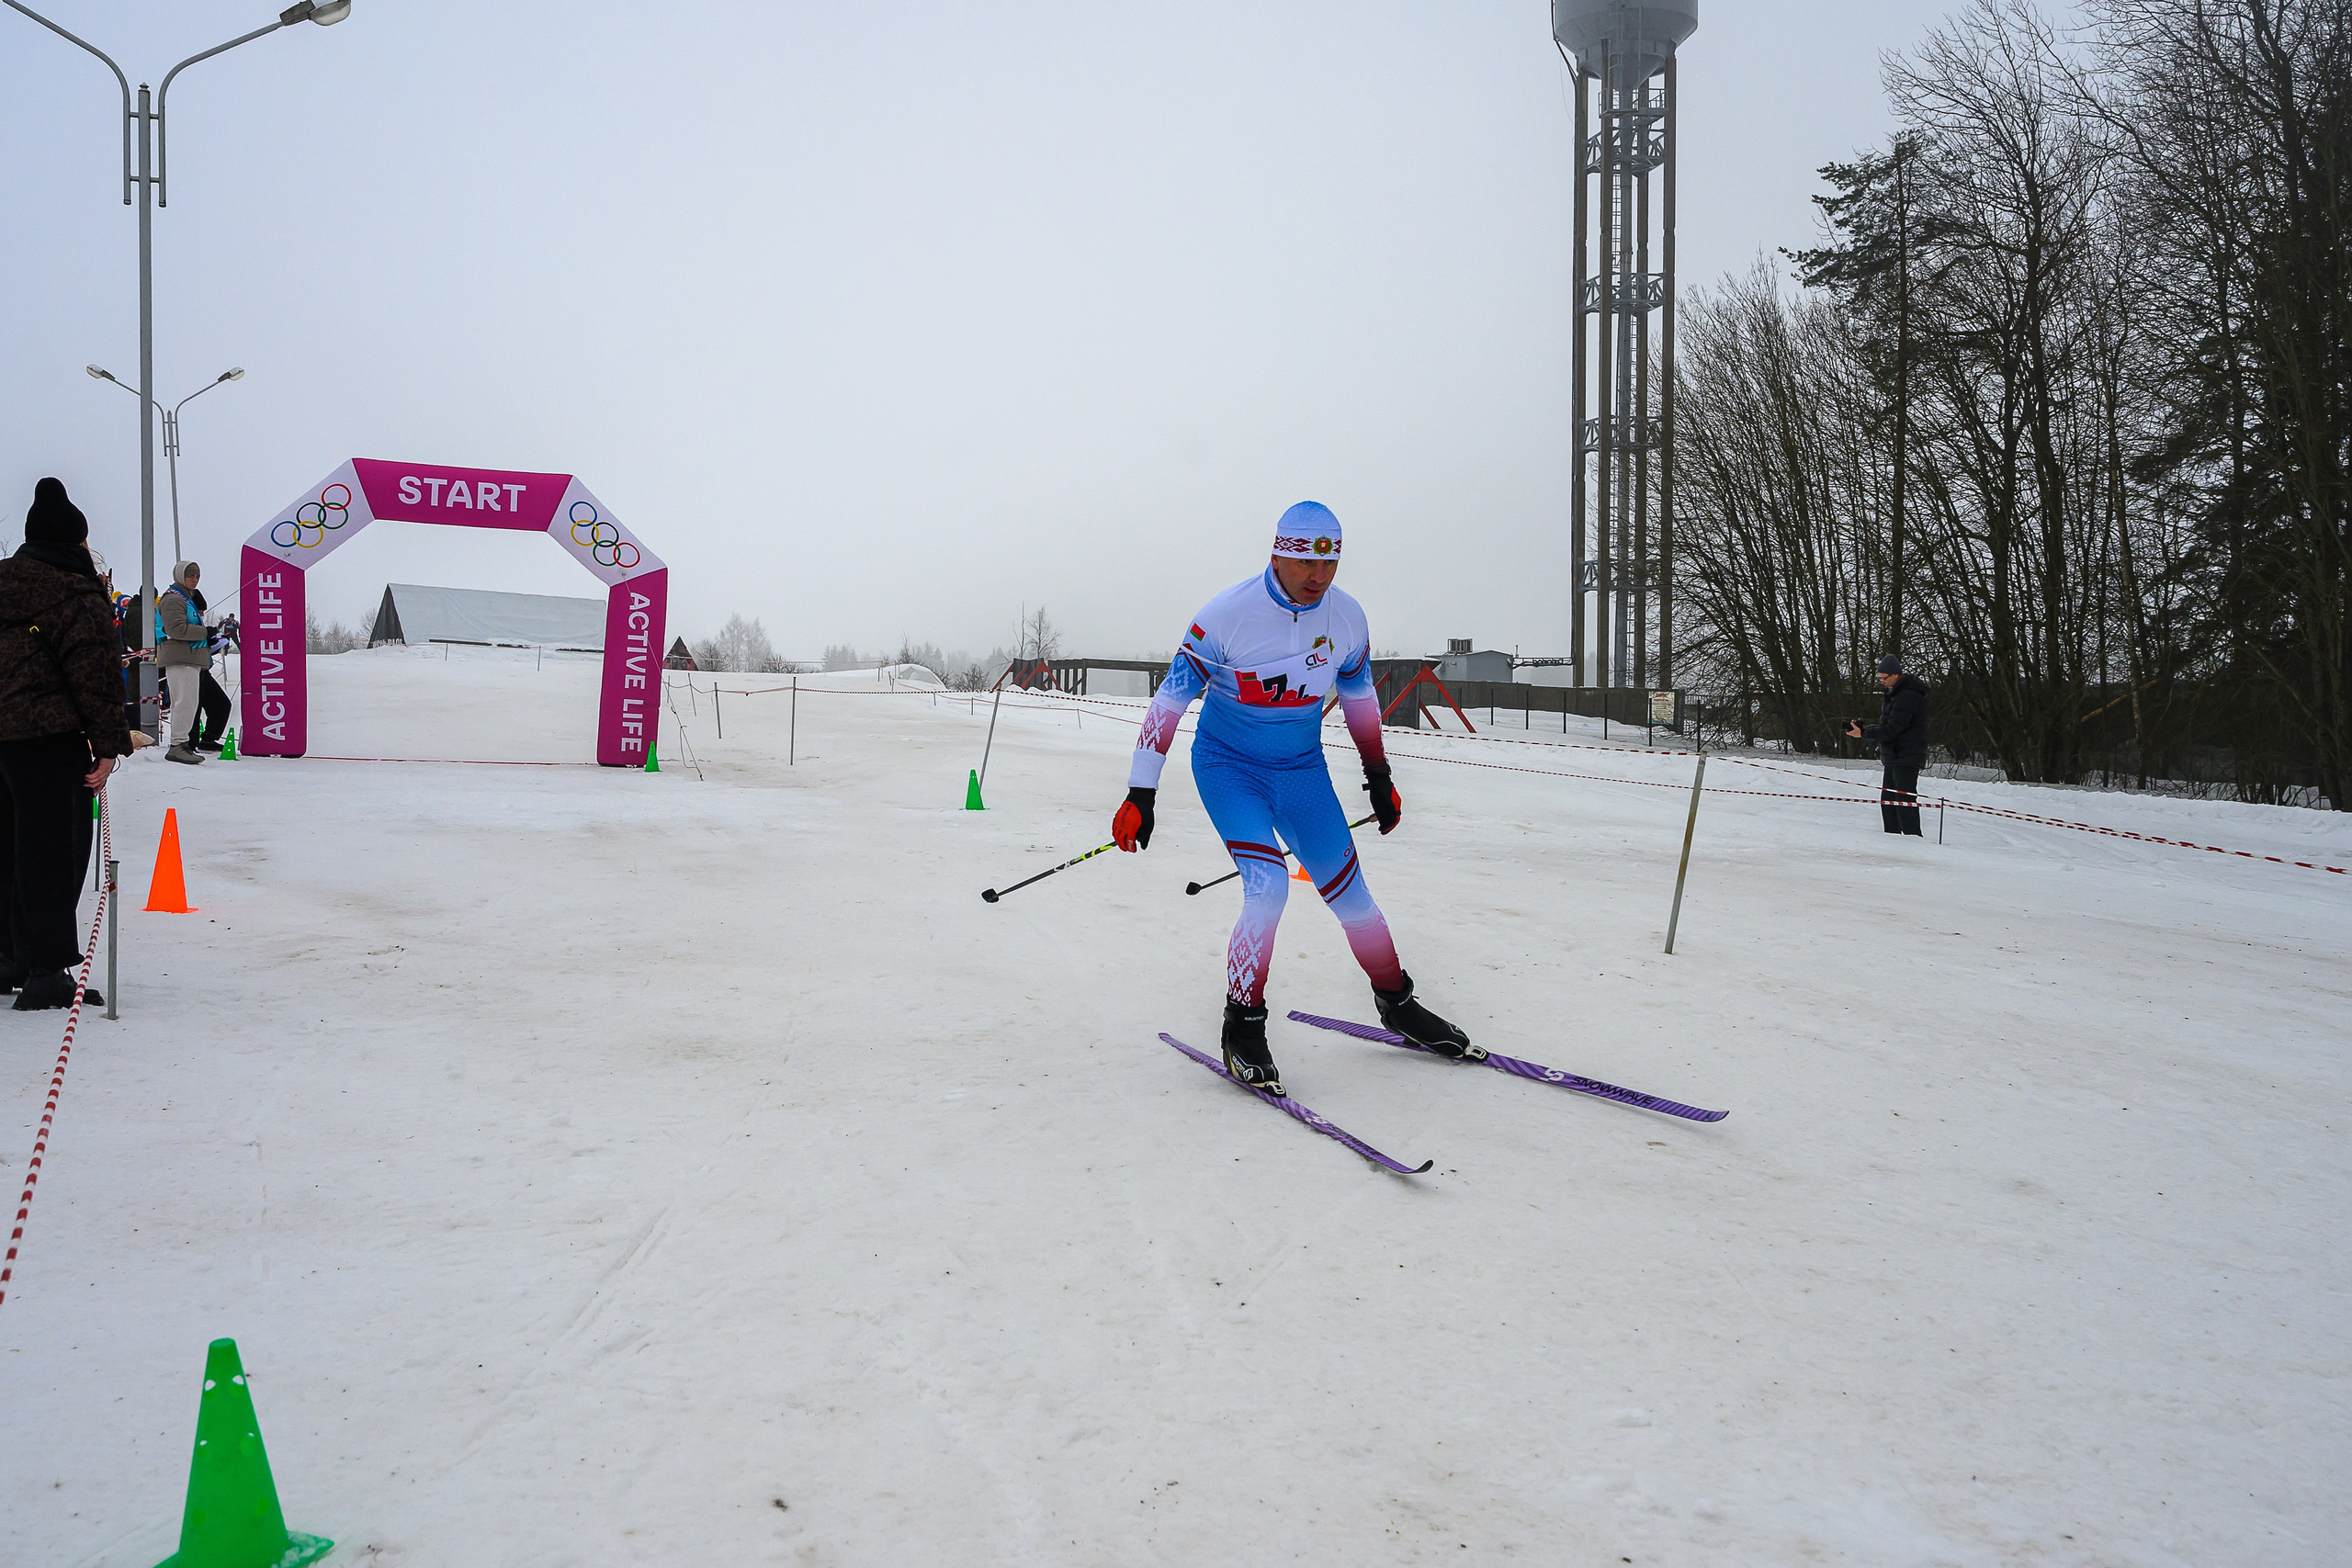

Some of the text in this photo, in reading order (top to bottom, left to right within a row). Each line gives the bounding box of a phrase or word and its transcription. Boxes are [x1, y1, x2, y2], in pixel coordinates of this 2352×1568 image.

[398, 475, 526, 513] START
[258, 572, 286, 740] ACTIVE LIFE
[621, 592, 650, 752] ACTIVE LIFE
[1570, 1076, 1656, 1105] SNOWWAVE
